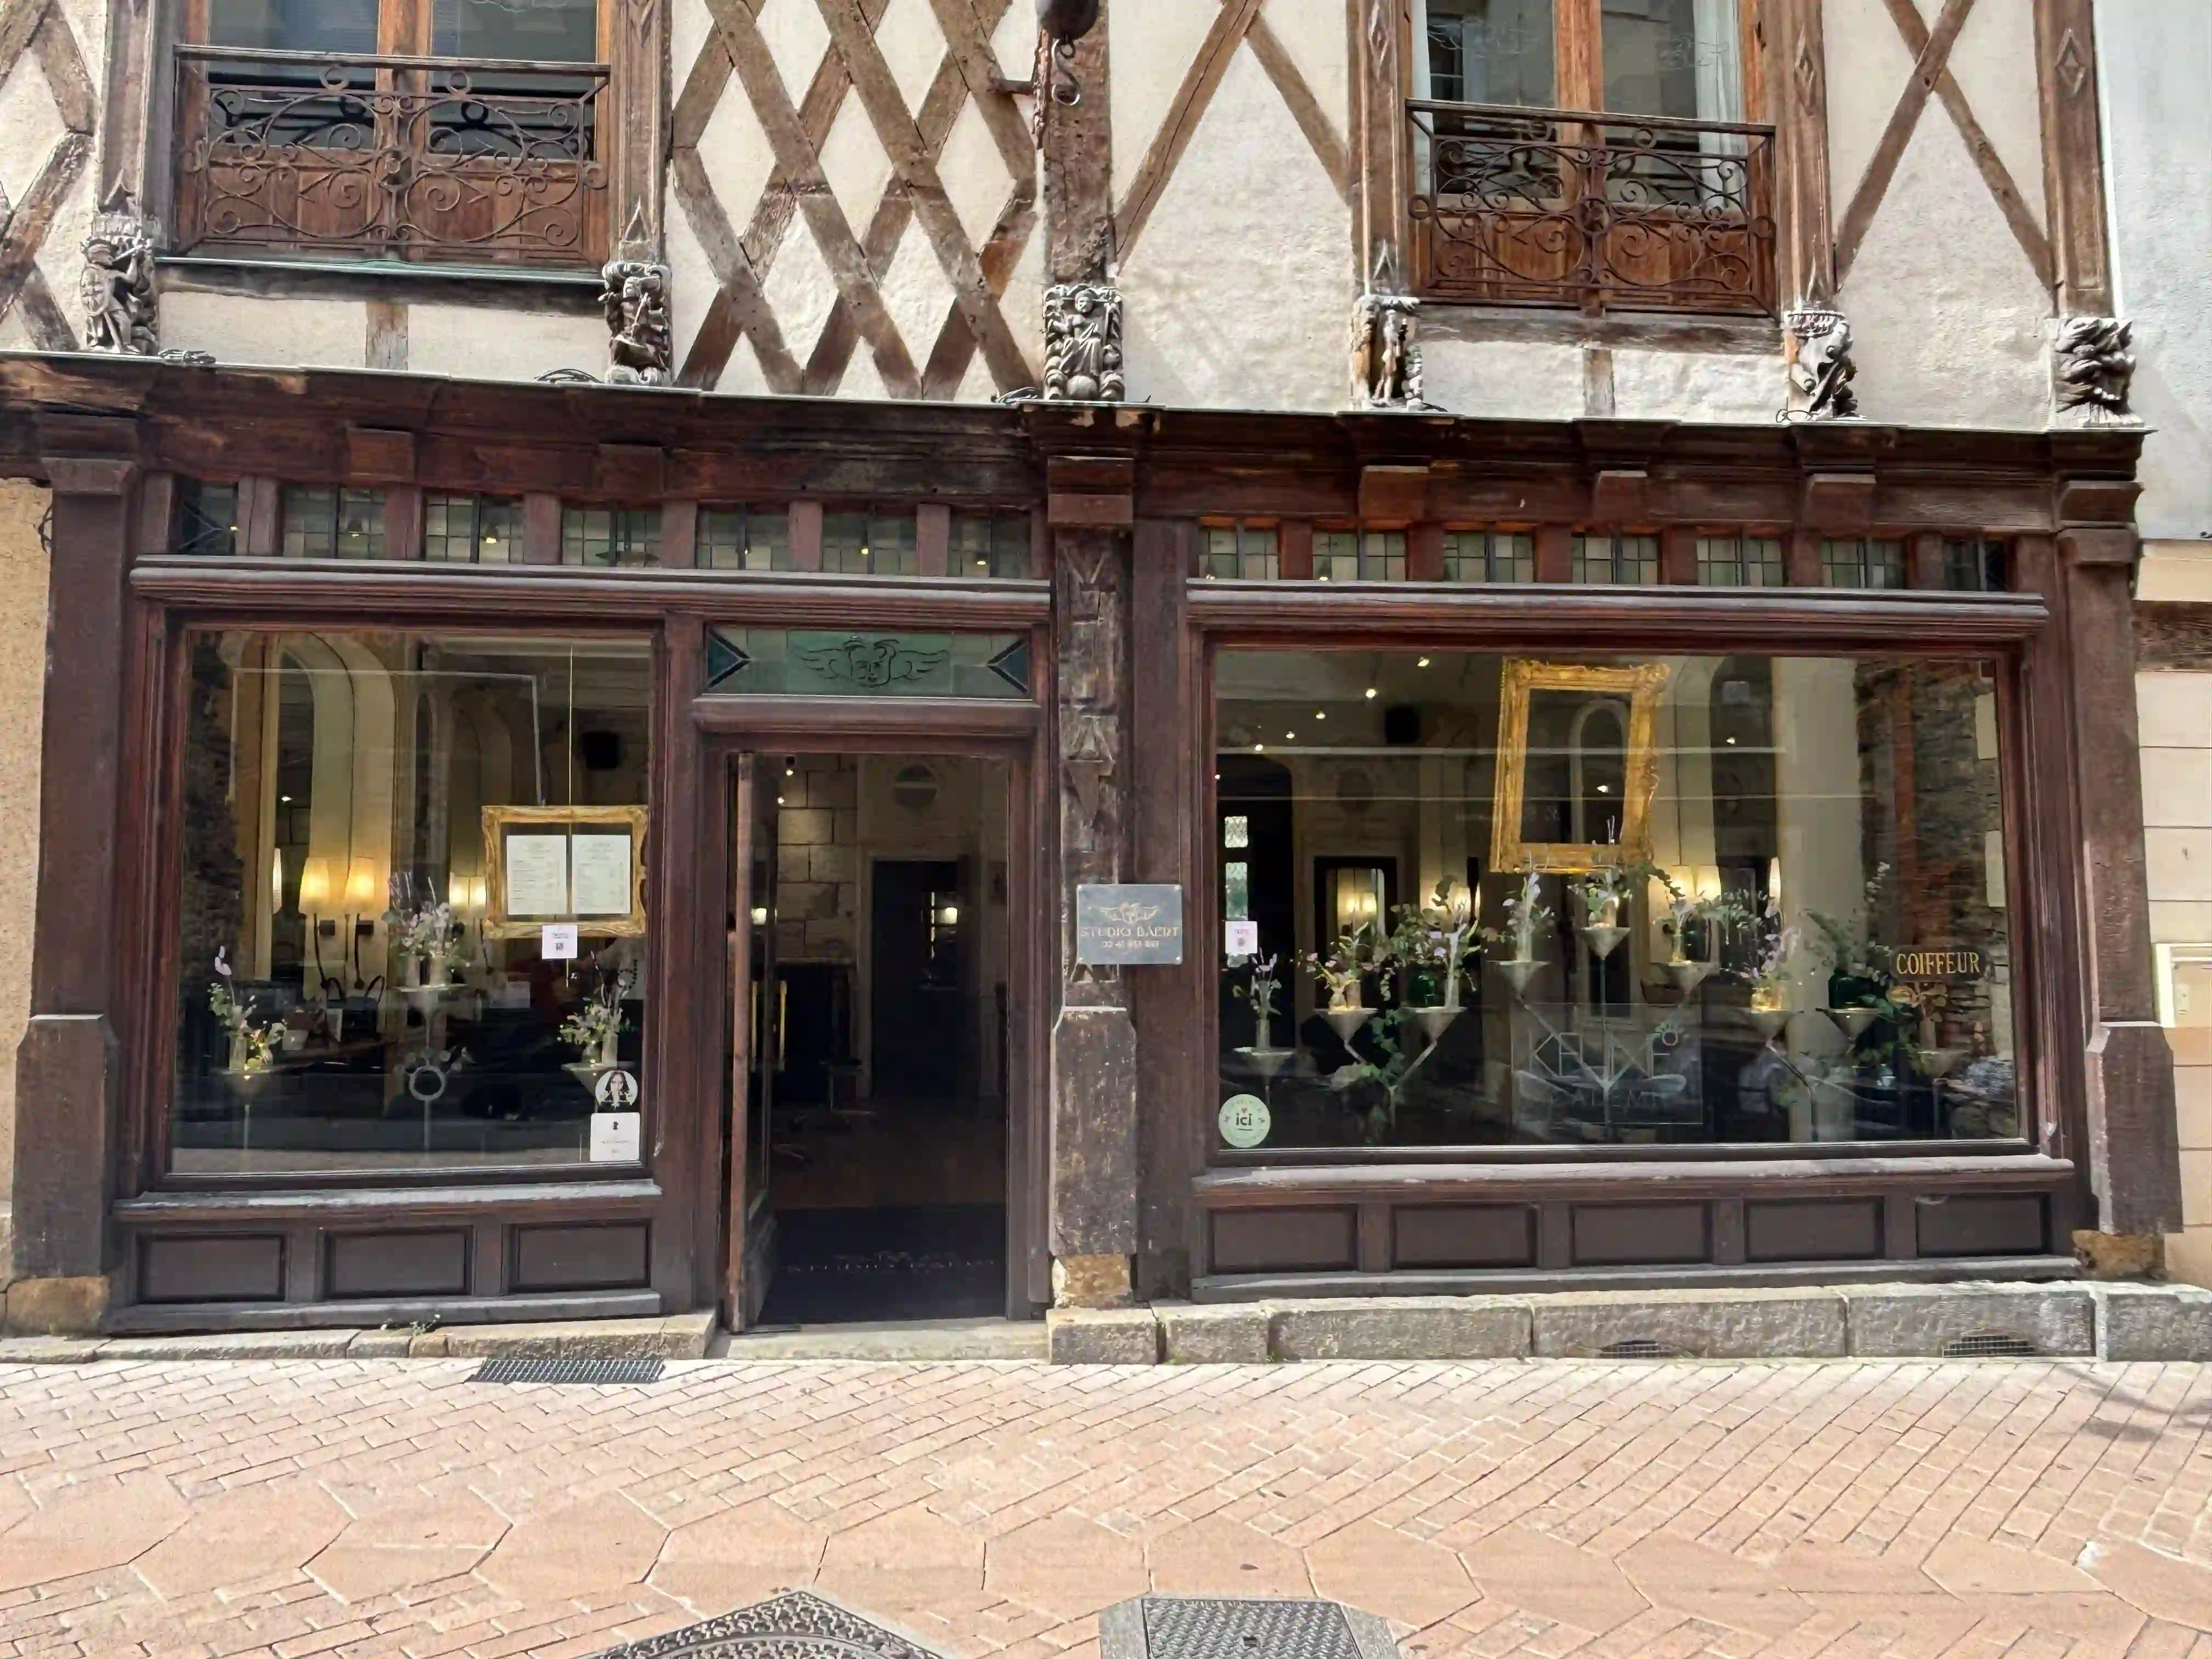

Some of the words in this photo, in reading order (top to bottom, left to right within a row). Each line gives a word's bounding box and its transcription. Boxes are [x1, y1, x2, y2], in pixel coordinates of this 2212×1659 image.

[1081, 927, 1131, 938] STUDIO
[1896, 952, 1981, 975] COIFFEUR
[1235, 1112, 1253, 1126] ici
